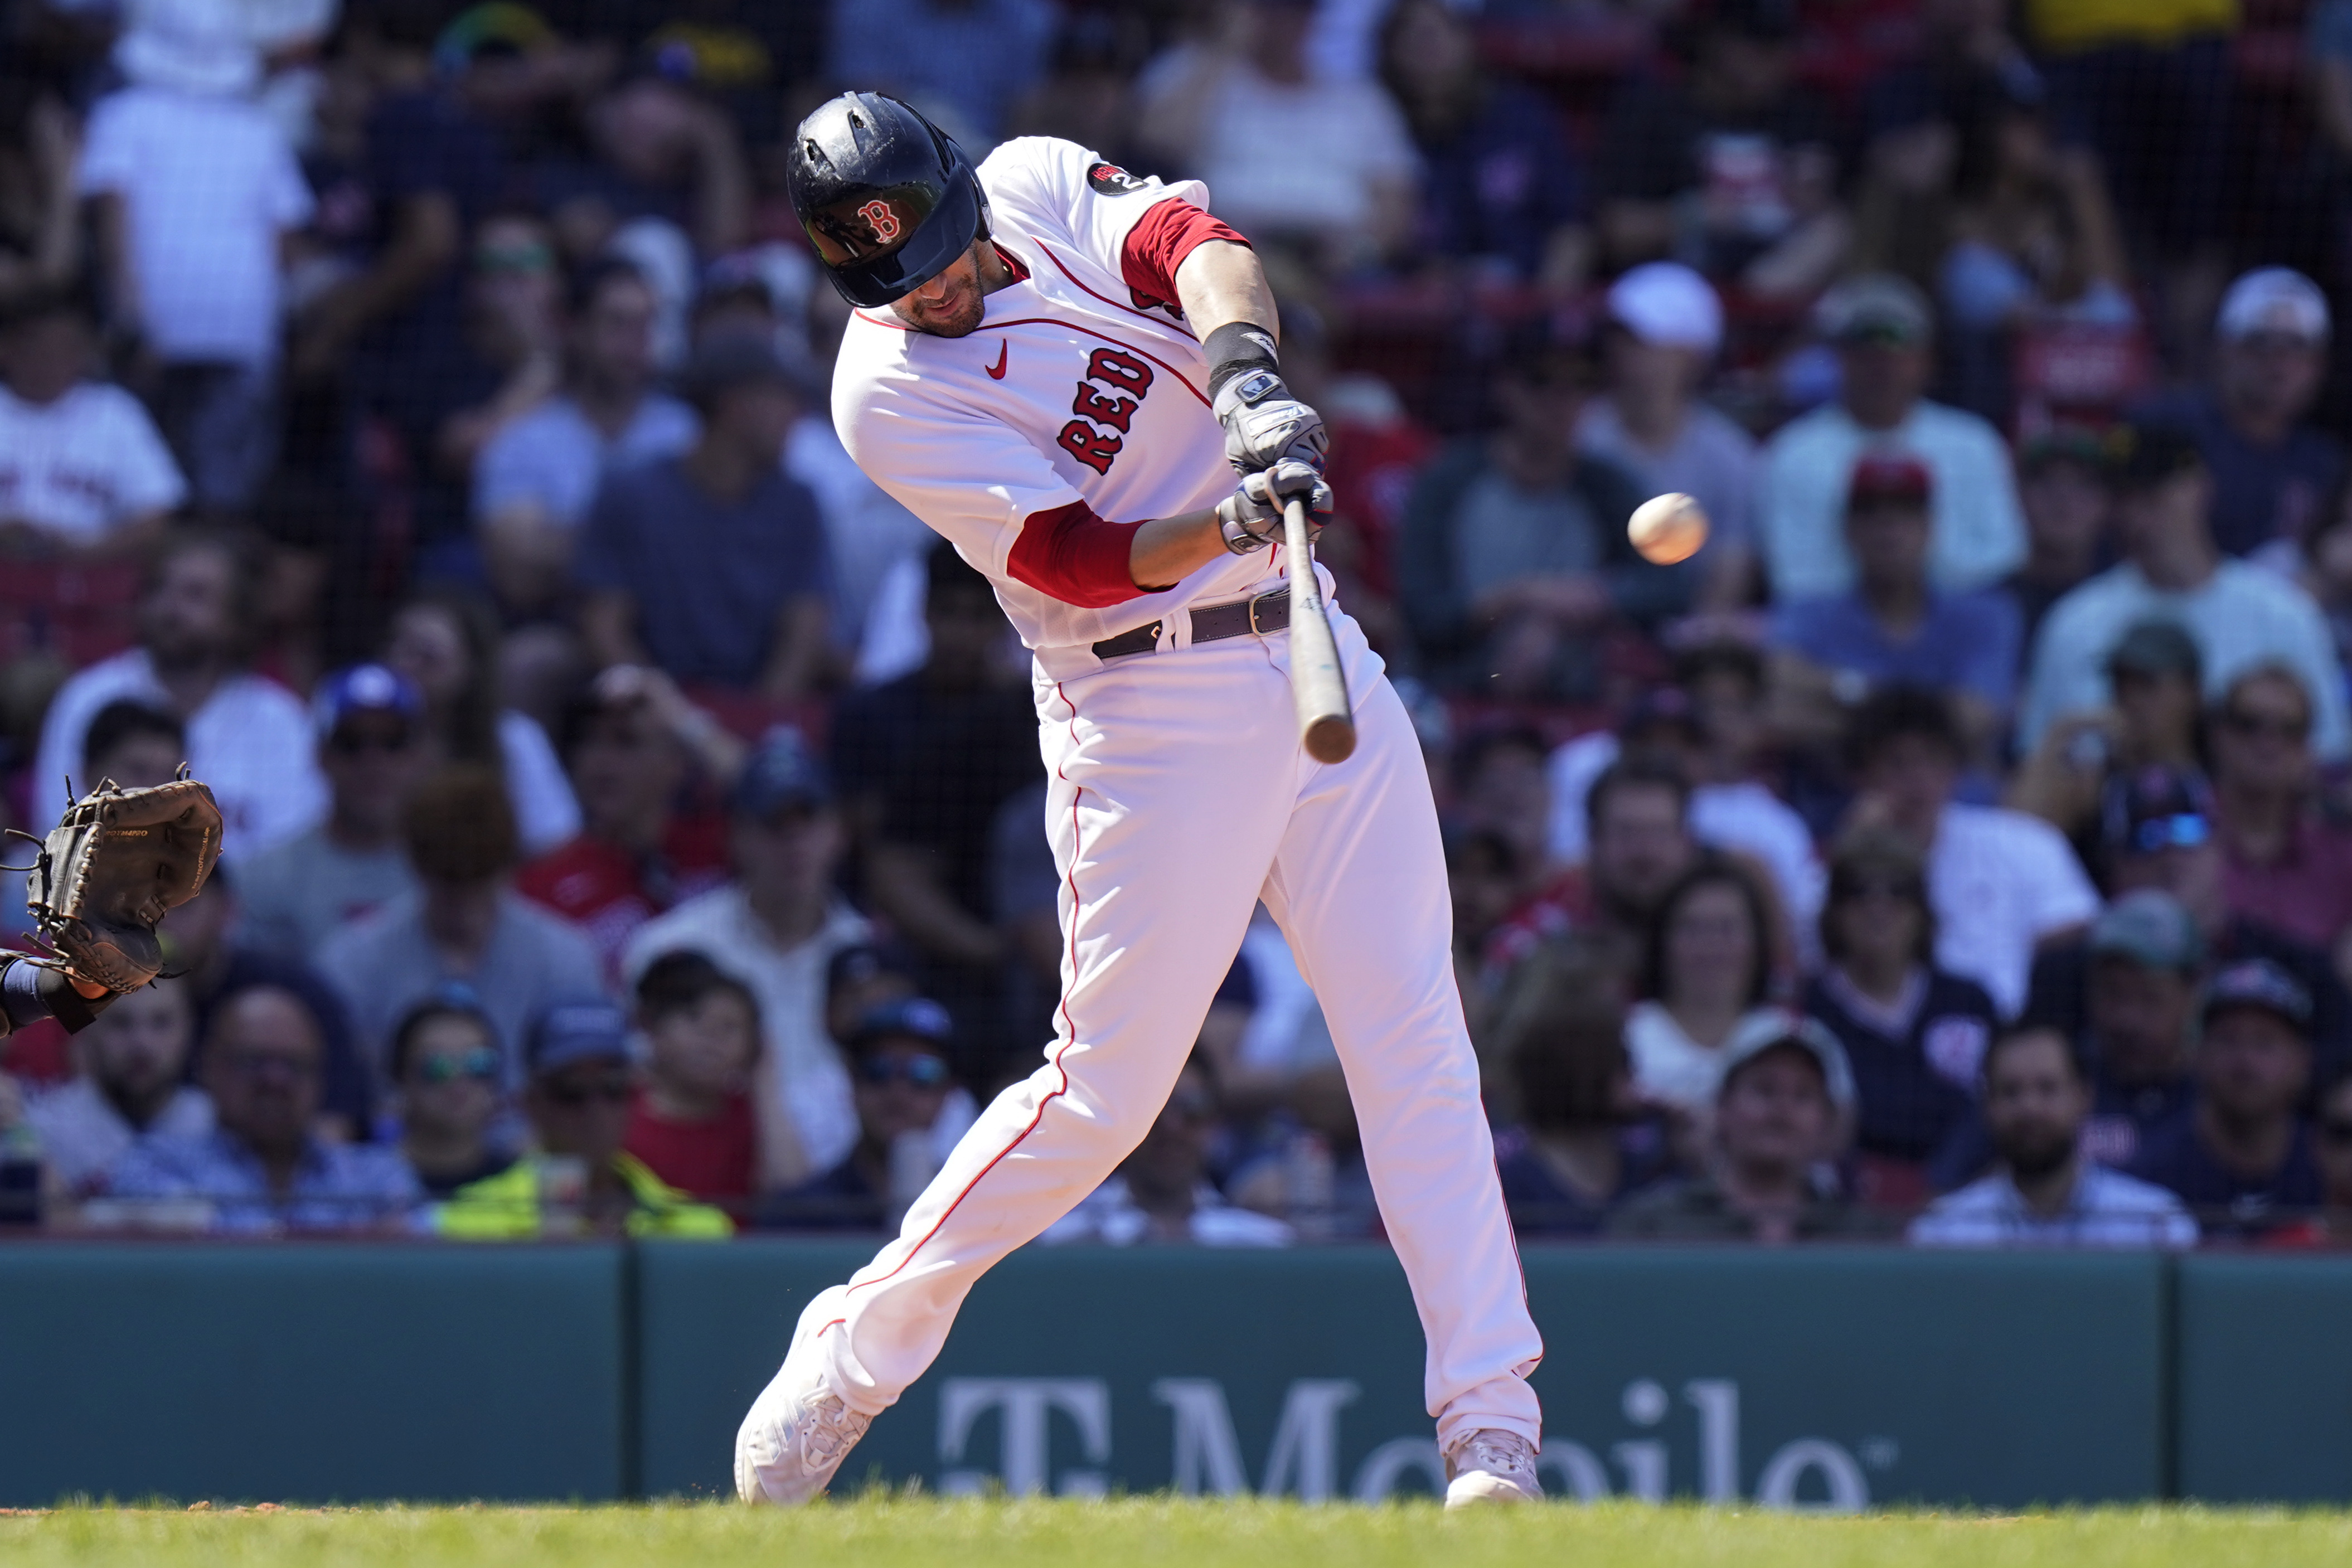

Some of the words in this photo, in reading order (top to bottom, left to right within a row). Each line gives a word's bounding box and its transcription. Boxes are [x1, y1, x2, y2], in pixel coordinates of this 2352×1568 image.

[857, 200, 899, 244] B
[1111, 173, 1143, 190] 2
[1056, 347, 1154, 476] RED
[938, 1376, 1112, 1499] T
